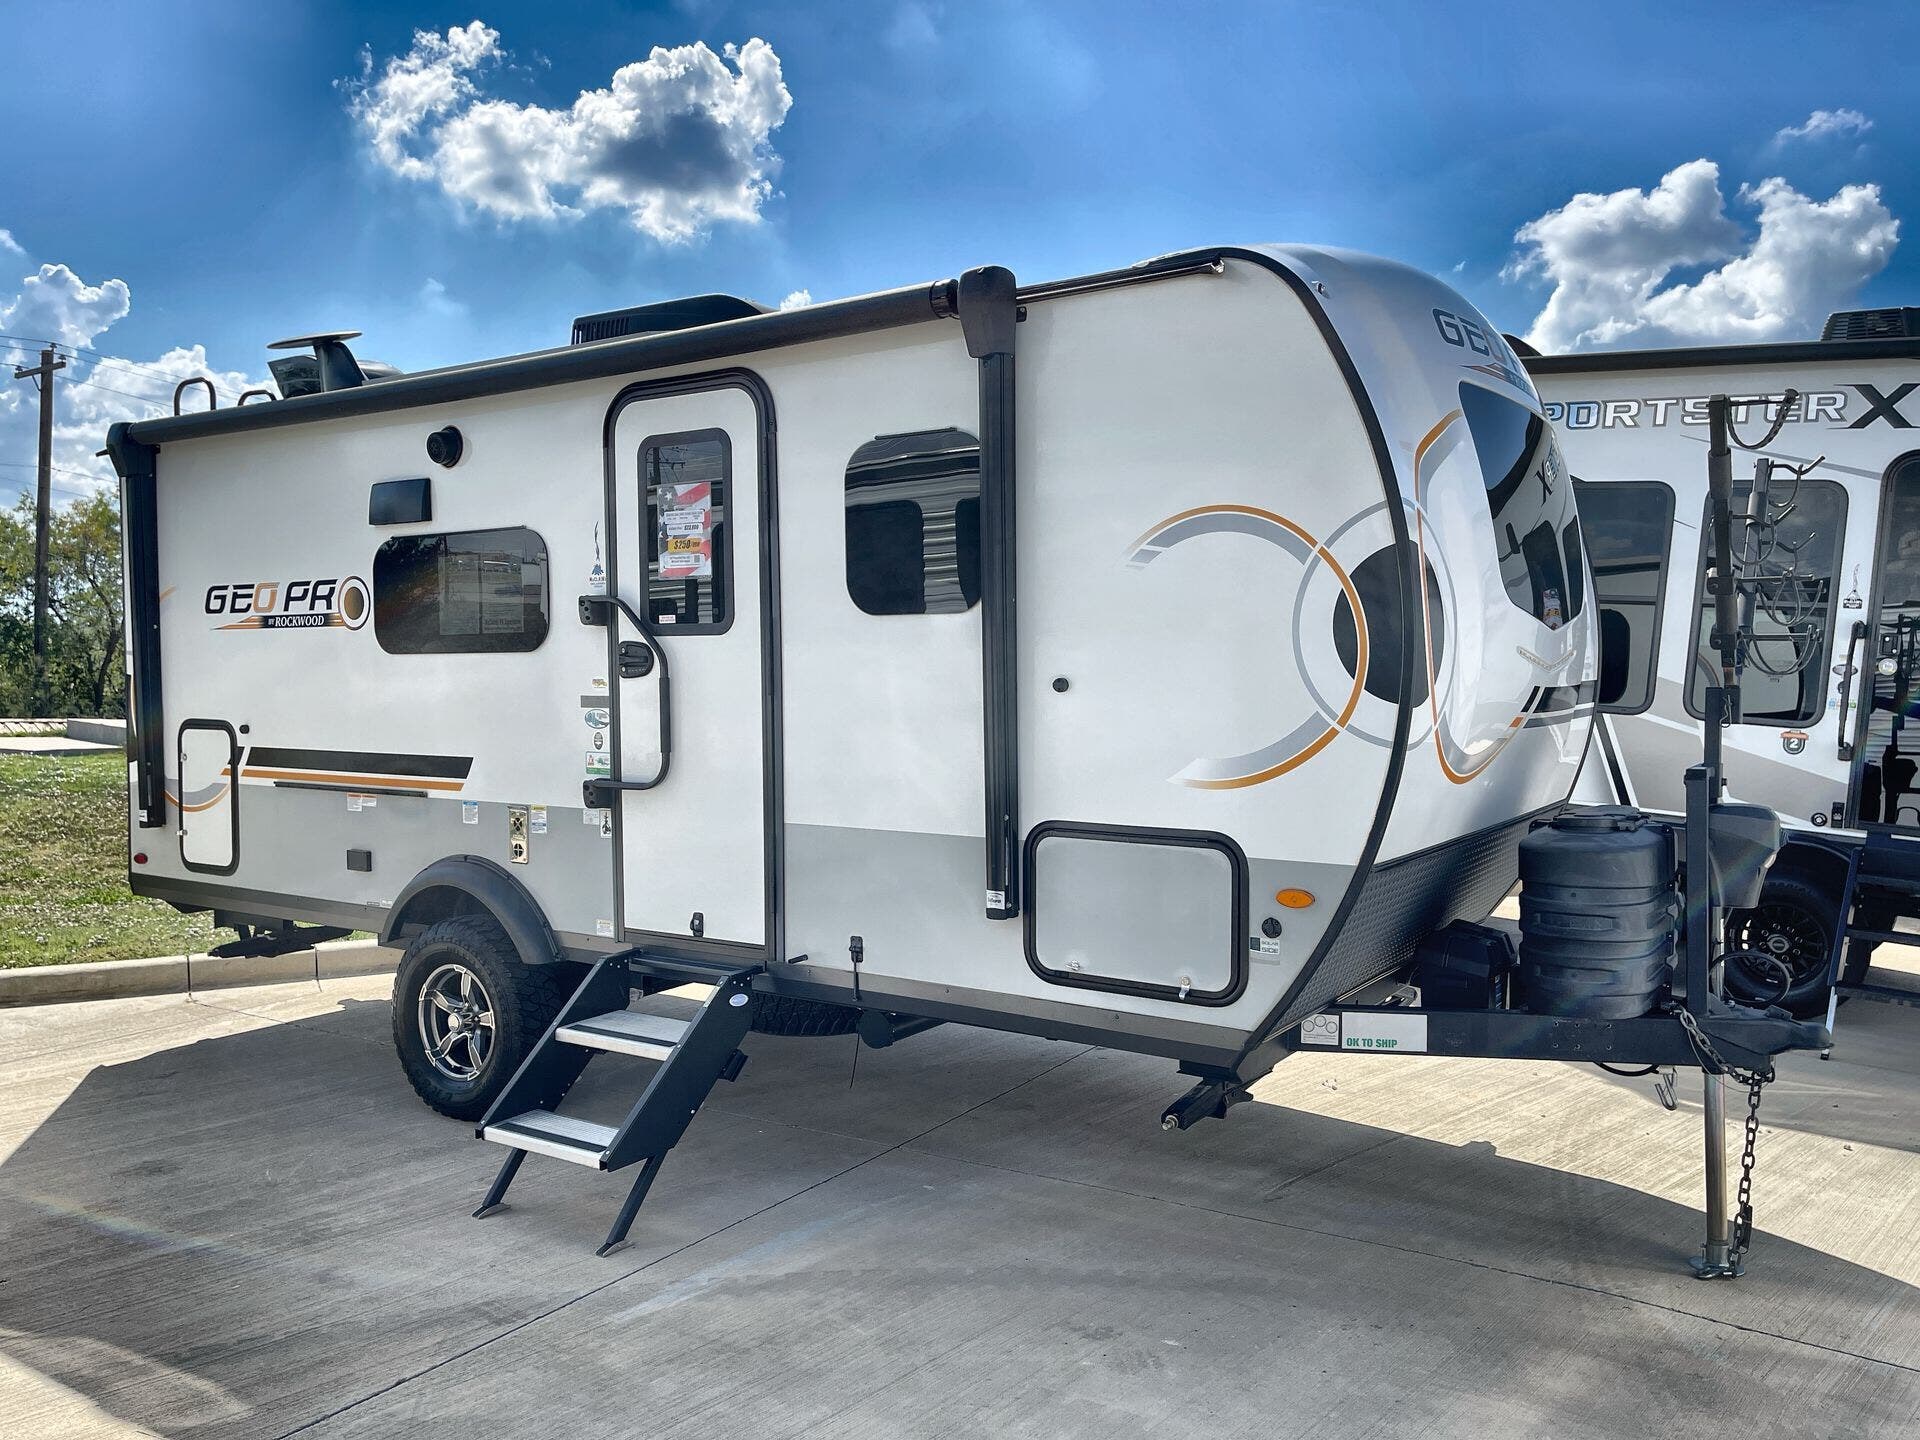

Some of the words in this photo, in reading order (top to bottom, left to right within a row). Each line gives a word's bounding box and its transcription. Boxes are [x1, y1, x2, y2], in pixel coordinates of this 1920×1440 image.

[205, 582, 281, 614] GEO
[275, 615, 325, 627] ROCKWOOD
[1346, 1037, 1359, 1047] OK
[1362, 1038, 1373, 1048] TO
[1376, 1038, 1398, 1049] SHIP
